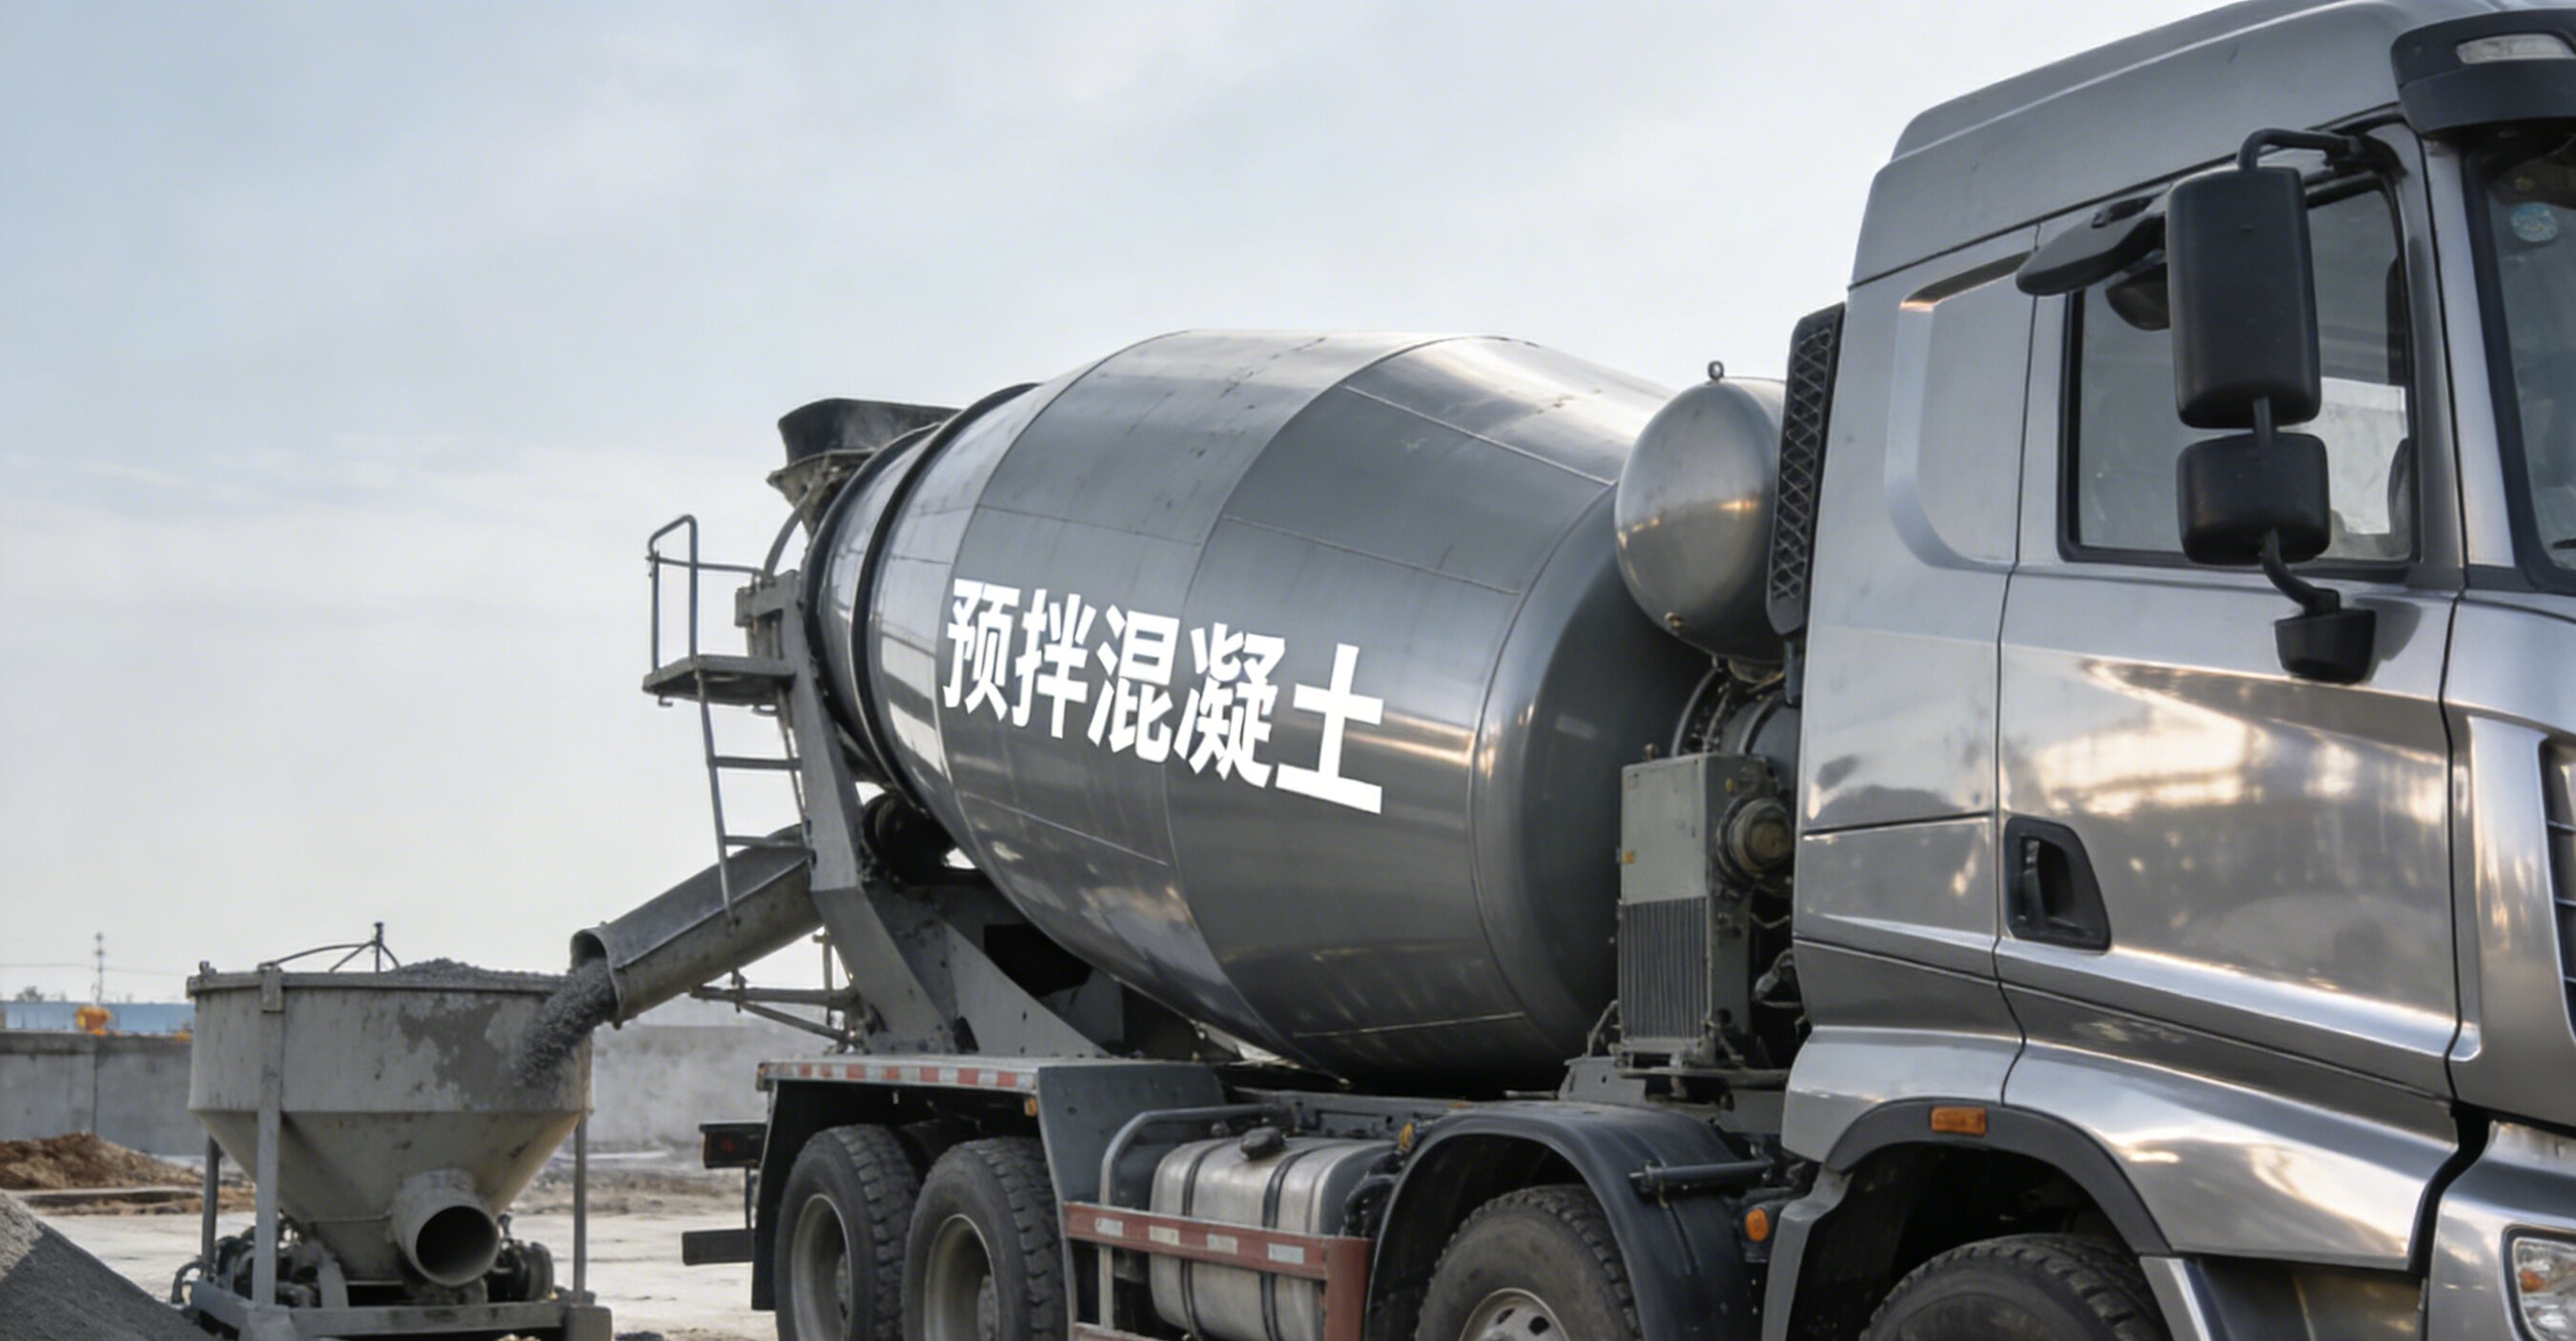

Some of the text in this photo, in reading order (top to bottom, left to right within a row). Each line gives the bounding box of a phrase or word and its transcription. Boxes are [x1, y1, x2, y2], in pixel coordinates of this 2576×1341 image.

[942, 578, 1384, 814] 预拌混凝土
